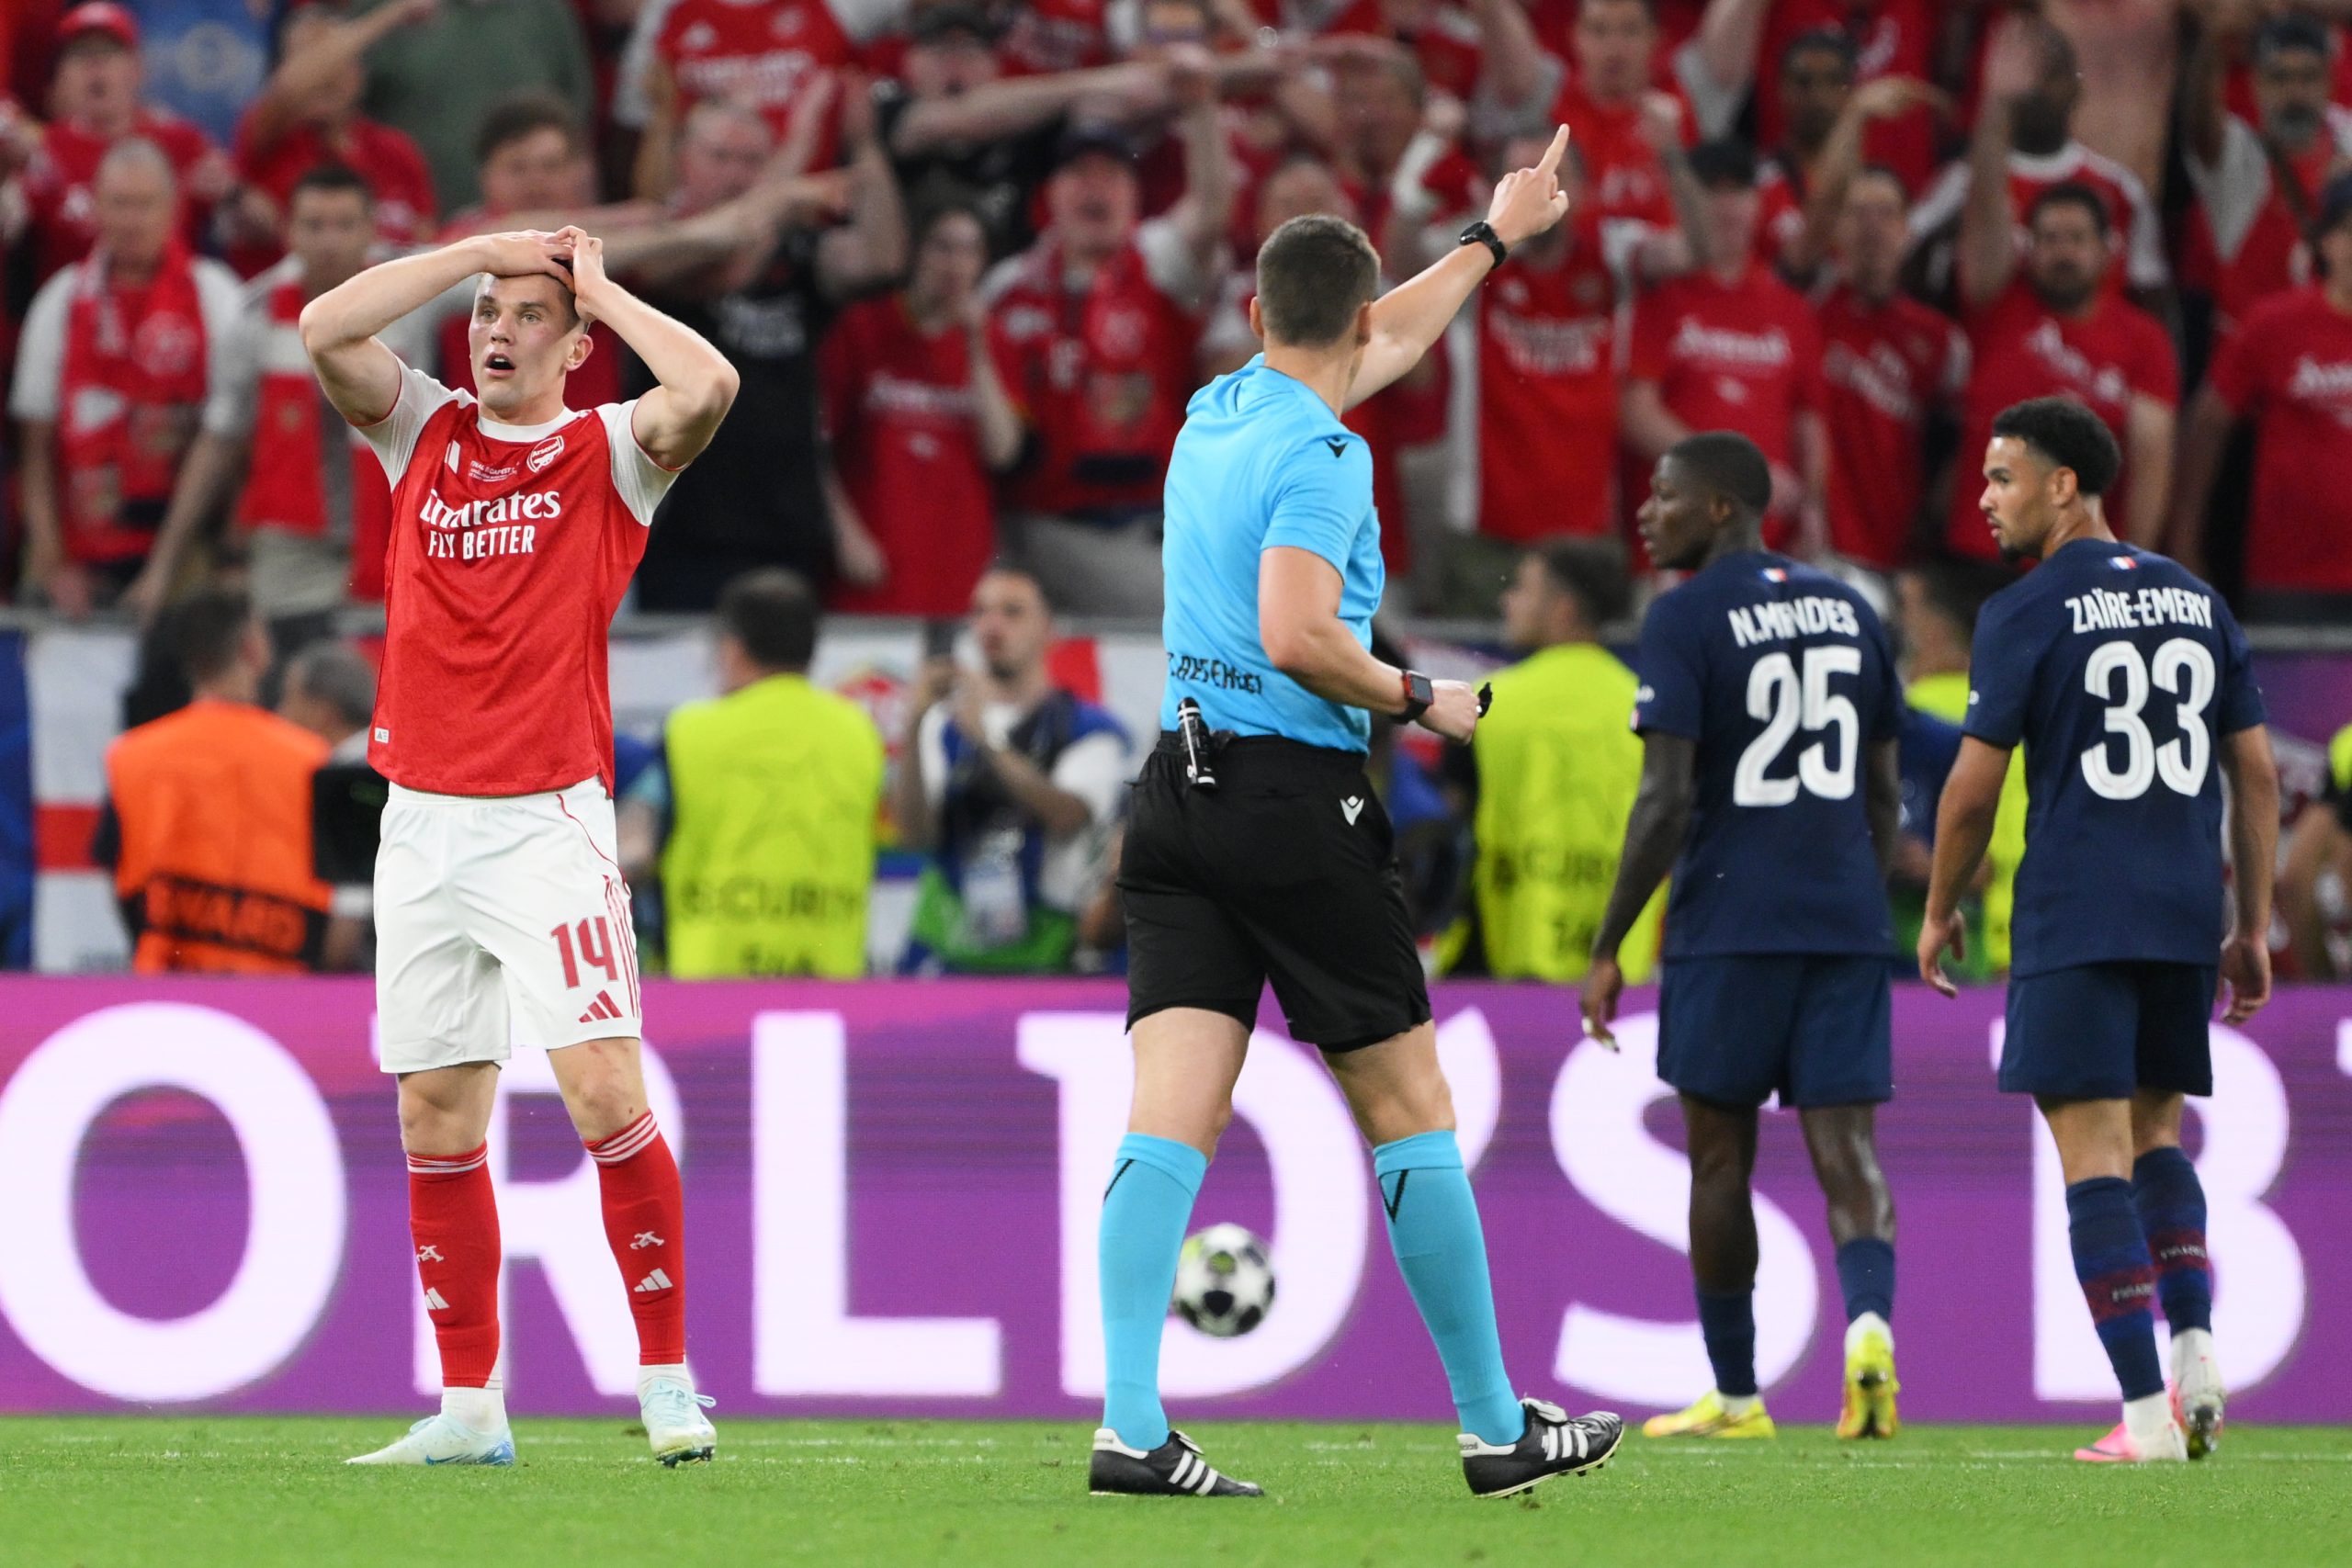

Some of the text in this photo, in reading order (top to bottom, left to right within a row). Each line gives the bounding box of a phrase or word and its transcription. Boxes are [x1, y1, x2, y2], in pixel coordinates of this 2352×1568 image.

[427, 525, 536, 560] FLY BETTER
[1727, 595, 1860, 649] N.MENDES
[2064, 587, 2213, 635] ZAÏRE-EMERY
[1733, 645, 1863, 807] 25
[2080, 637, 2216, 801] 33
[549, 916, 618, 990] 14
